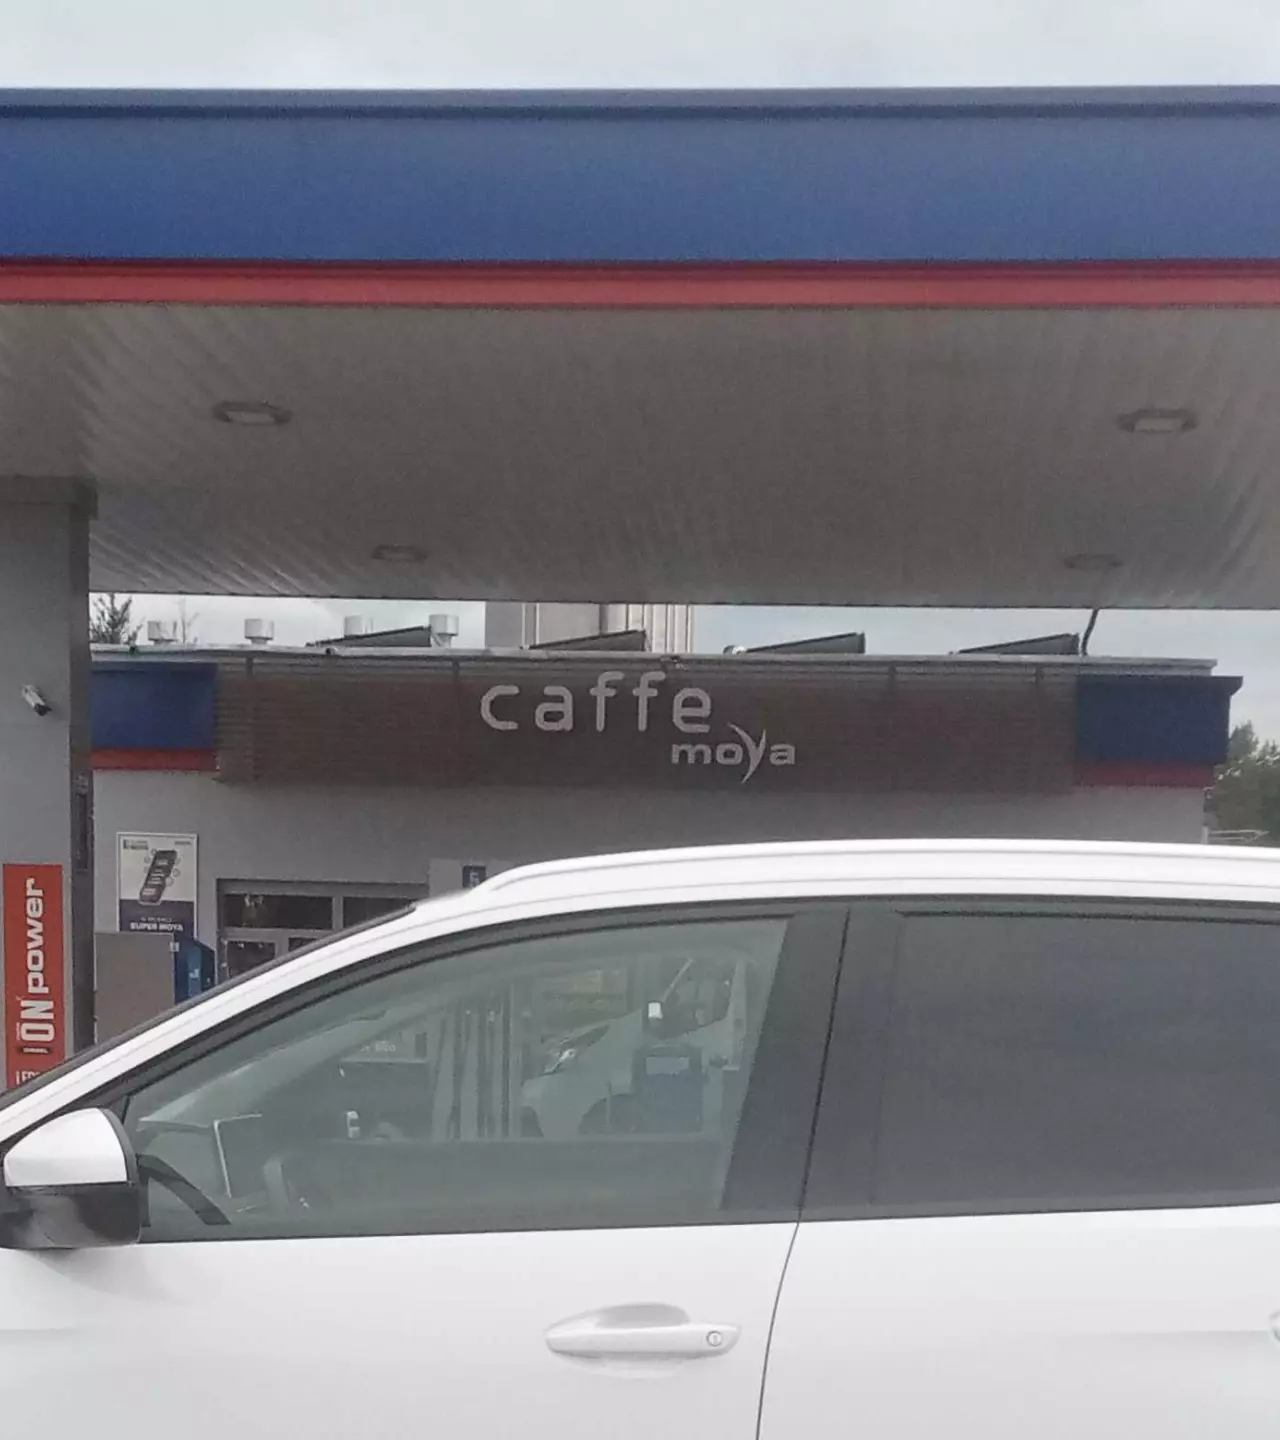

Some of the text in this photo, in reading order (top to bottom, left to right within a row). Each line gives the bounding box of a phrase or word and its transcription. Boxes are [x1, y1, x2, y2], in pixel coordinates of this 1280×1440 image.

[480, 671, 712, 733] caffe
[671, 722, 796, 784] moya
[26, 877, 50, 994] power
